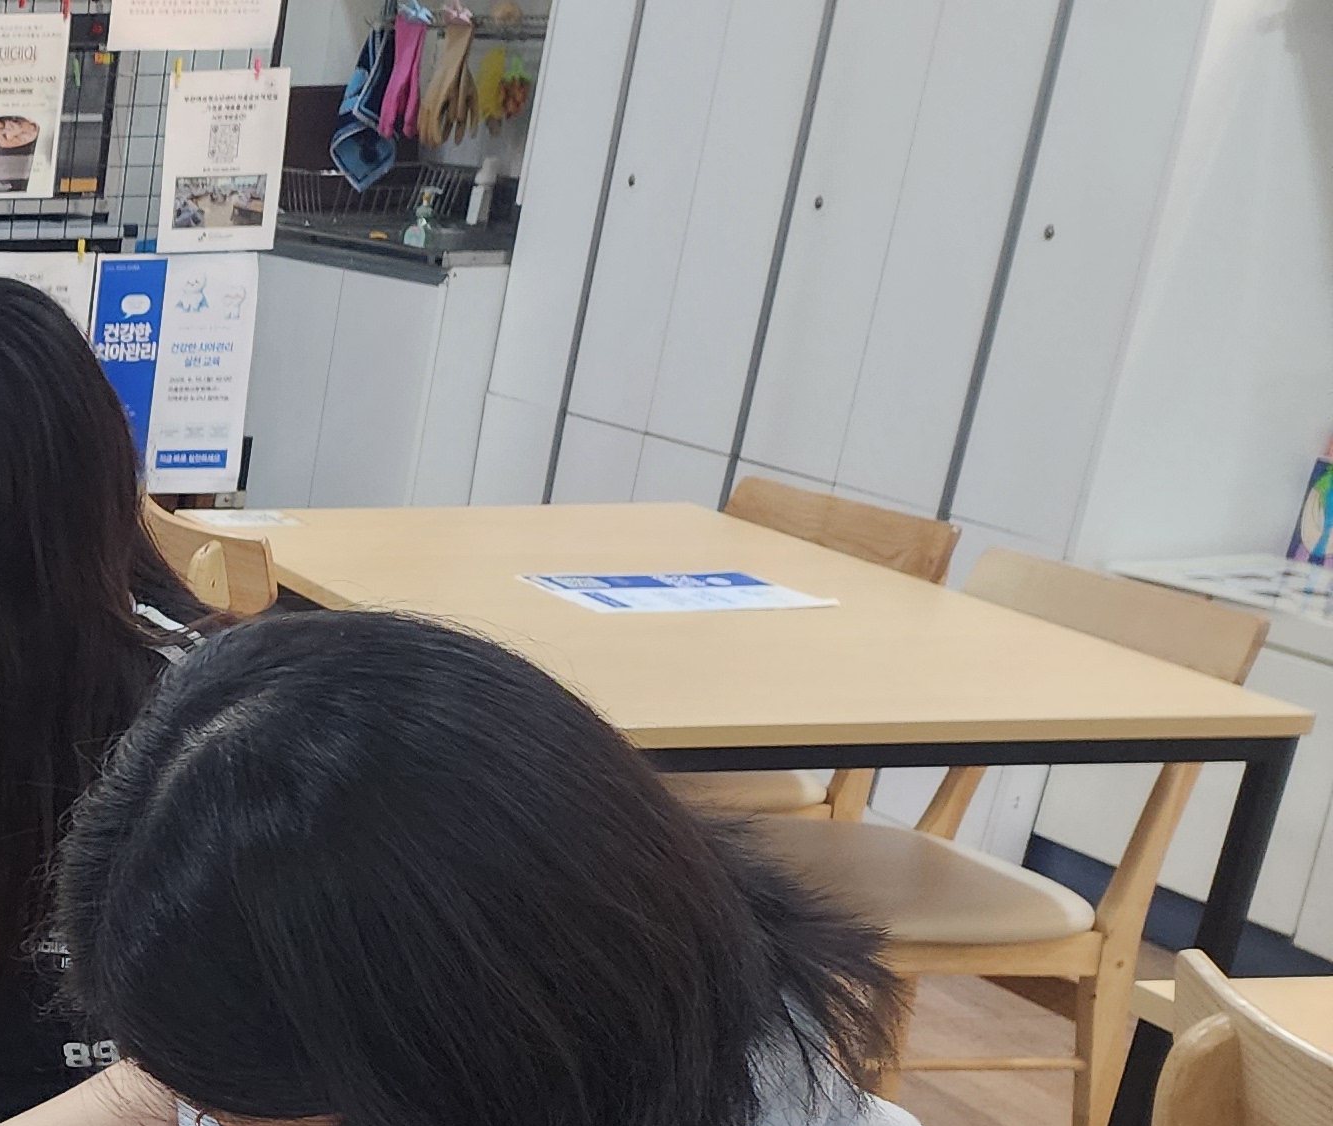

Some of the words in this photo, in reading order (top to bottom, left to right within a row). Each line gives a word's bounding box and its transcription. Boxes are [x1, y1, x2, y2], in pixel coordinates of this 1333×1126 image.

[103, 321, 153, 343] 건강한
[94, 341, 158, 362] 치아관리
[62, 1039, 121, 1069] 89
